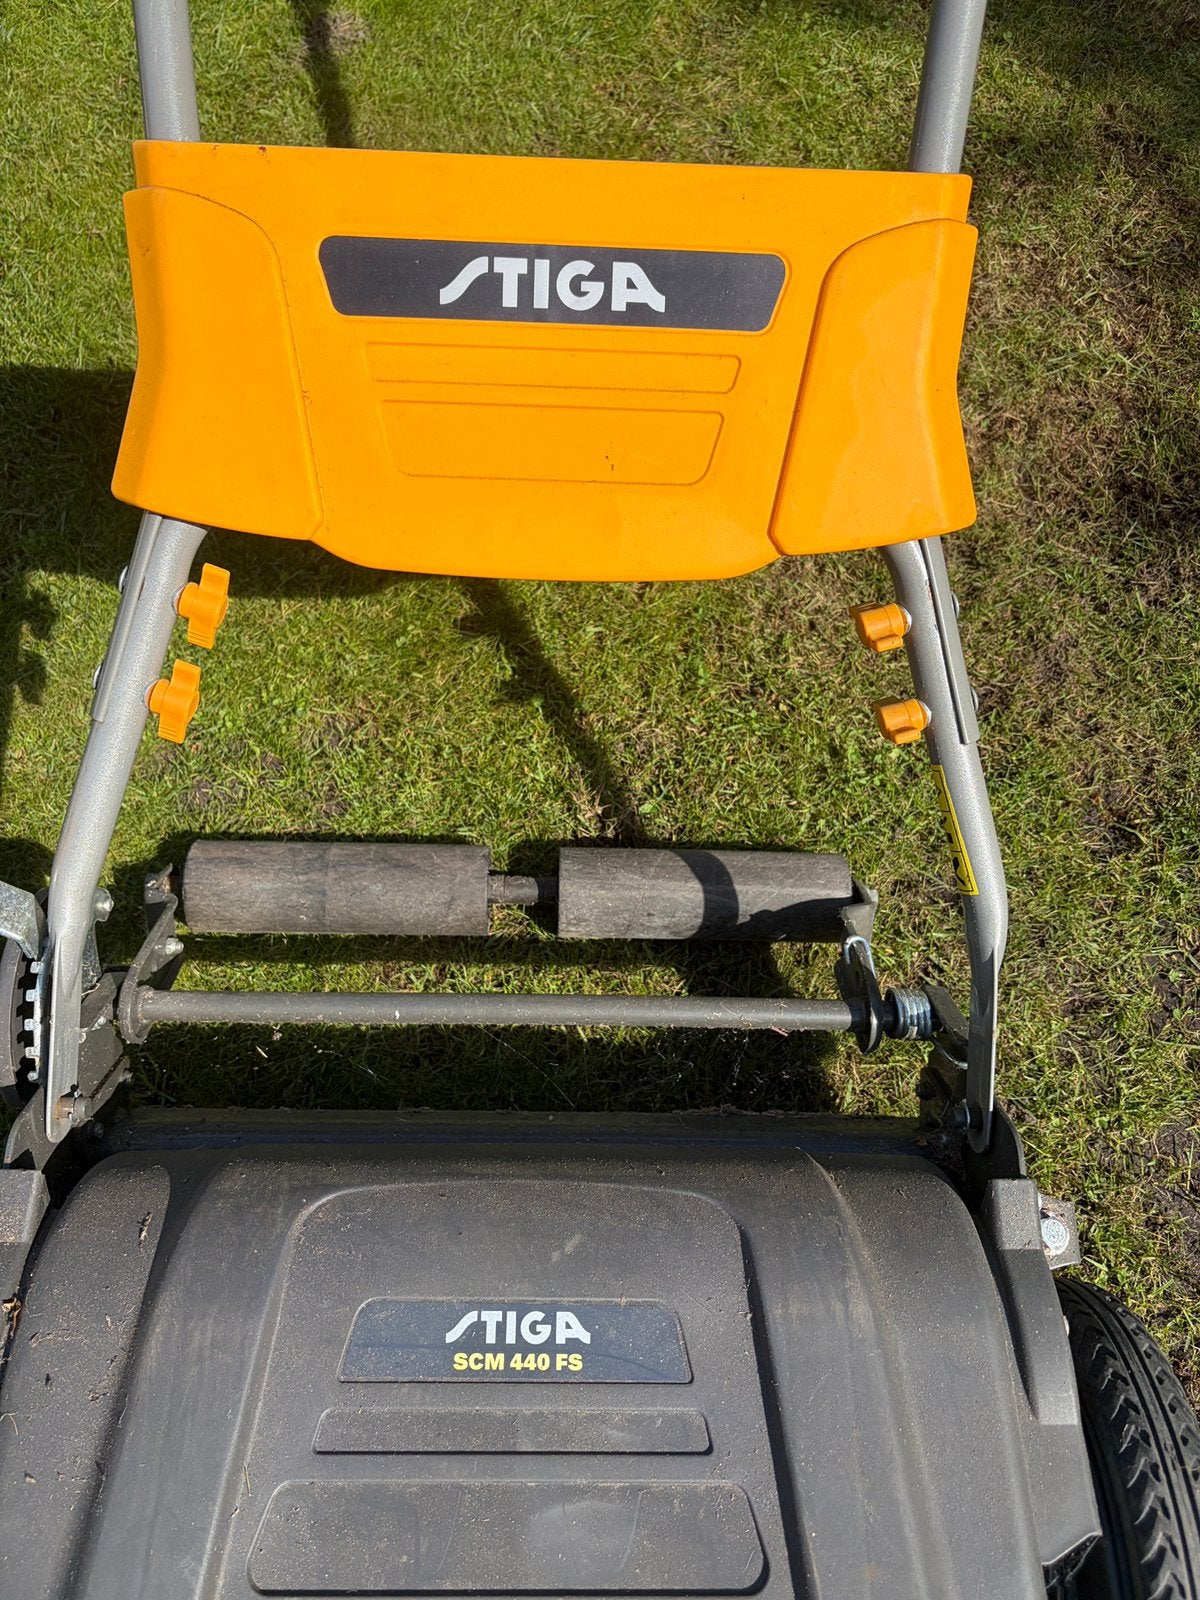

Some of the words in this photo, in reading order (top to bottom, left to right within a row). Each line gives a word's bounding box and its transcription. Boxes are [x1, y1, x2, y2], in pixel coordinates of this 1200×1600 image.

[439, 256, 666, 313] STIGA
[445, 1310, 591, 1345] STIGA
[453, 1352, 505, 1371] SCM
[509, 1353, 550, 1371] 440
[555, 1353, 583, 1372] FS
